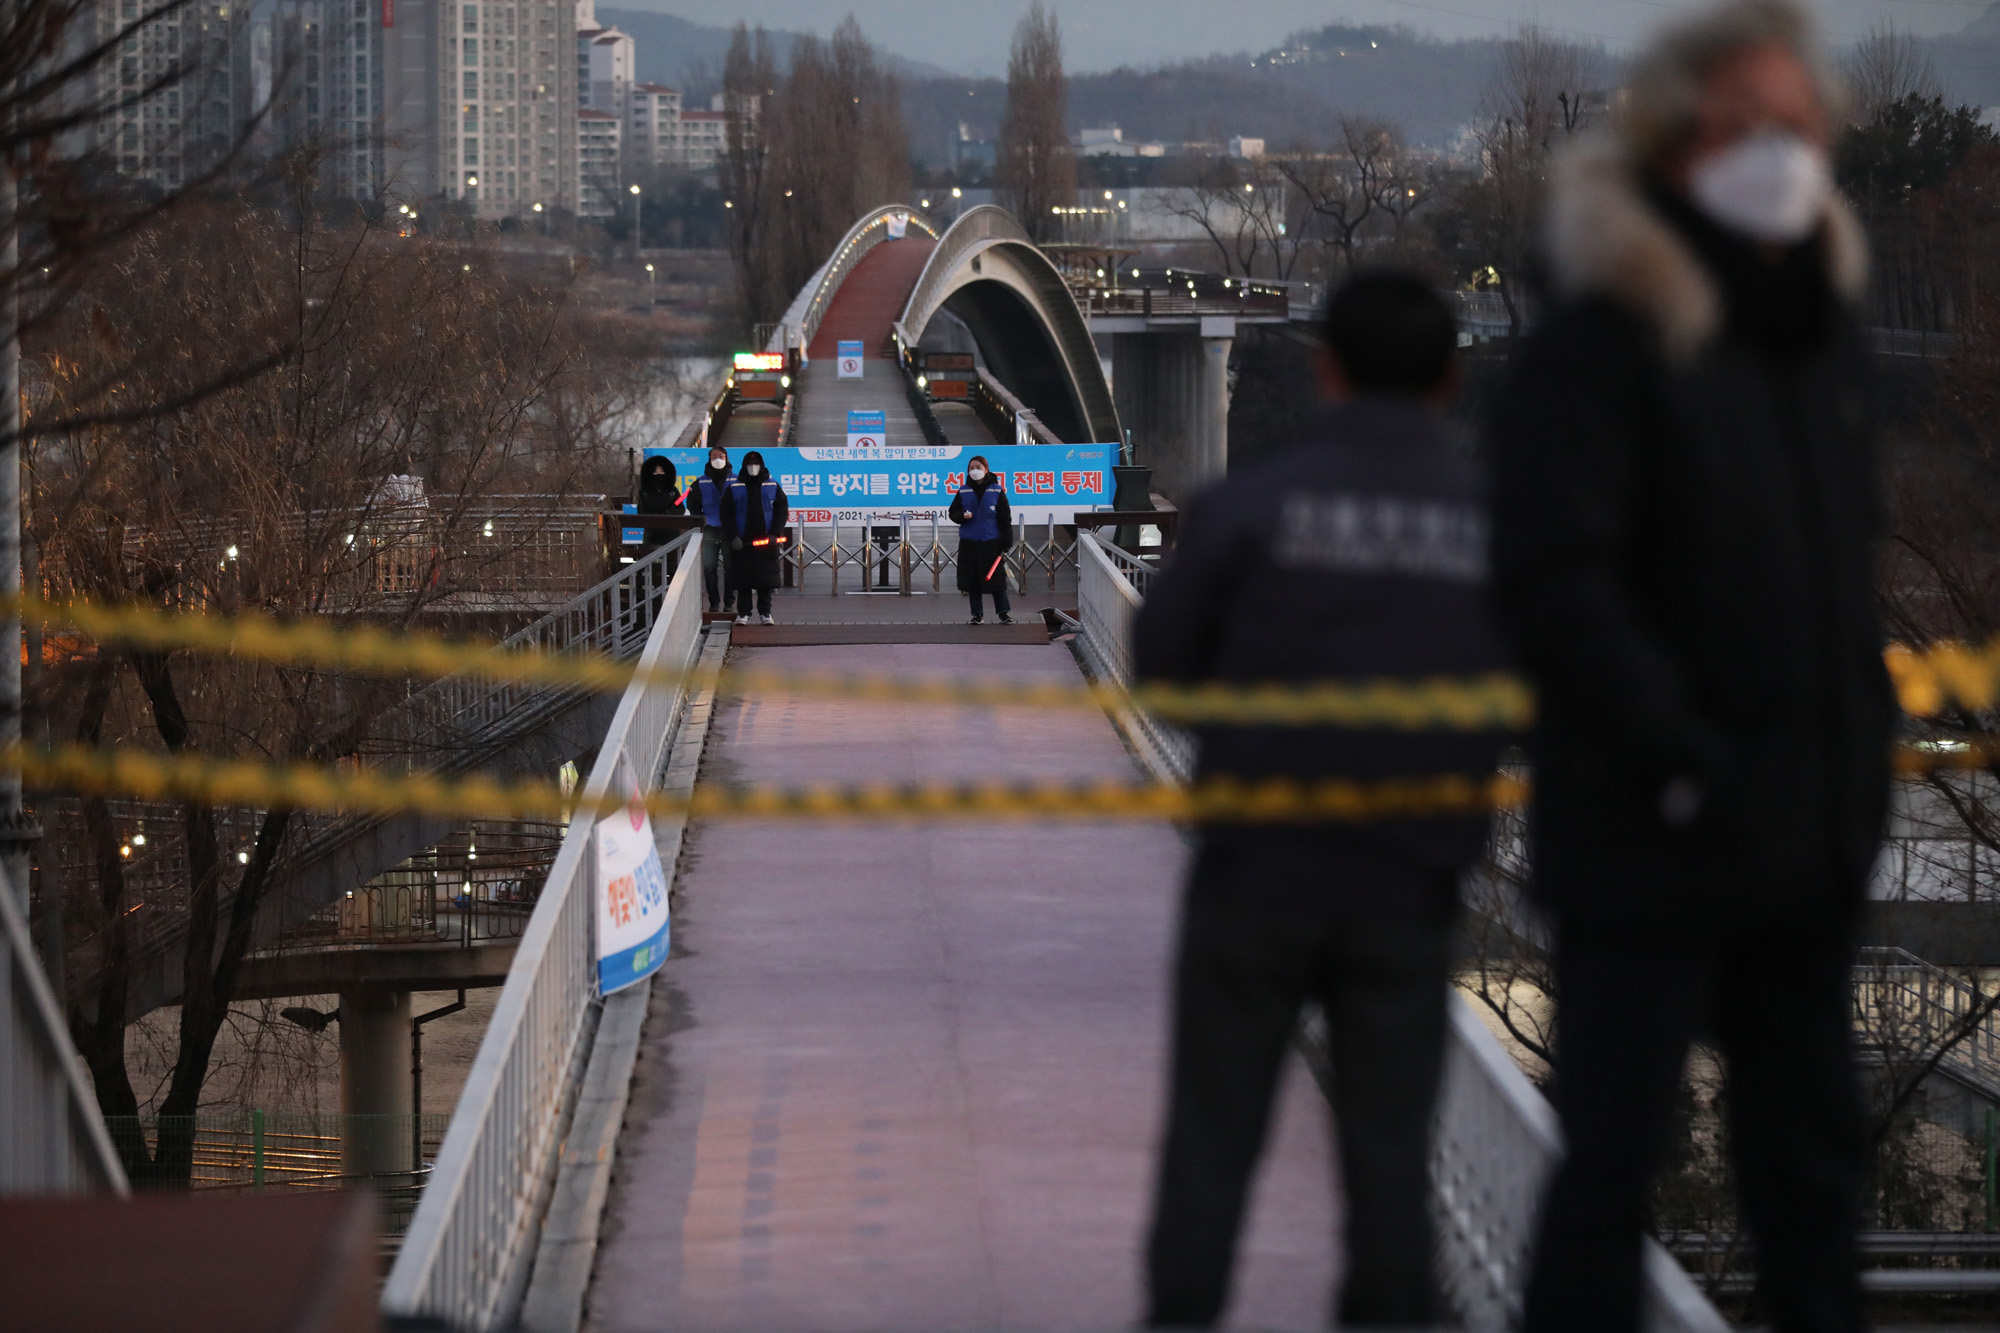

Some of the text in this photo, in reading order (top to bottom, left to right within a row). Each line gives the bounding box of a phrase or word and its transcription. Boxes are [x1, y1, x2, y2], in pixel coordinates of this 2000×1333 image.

[816, 447, 947, 459] 신축년 새해 복 많이 받으세요
[780, 474, 820, 496] 밀집
[828, 473, 890, 497] 방지를
[897, 472, 939, 495] 위한
[1013, 471, 1055, 494] 전면
[1061, 470, 1103, 495] 통제
